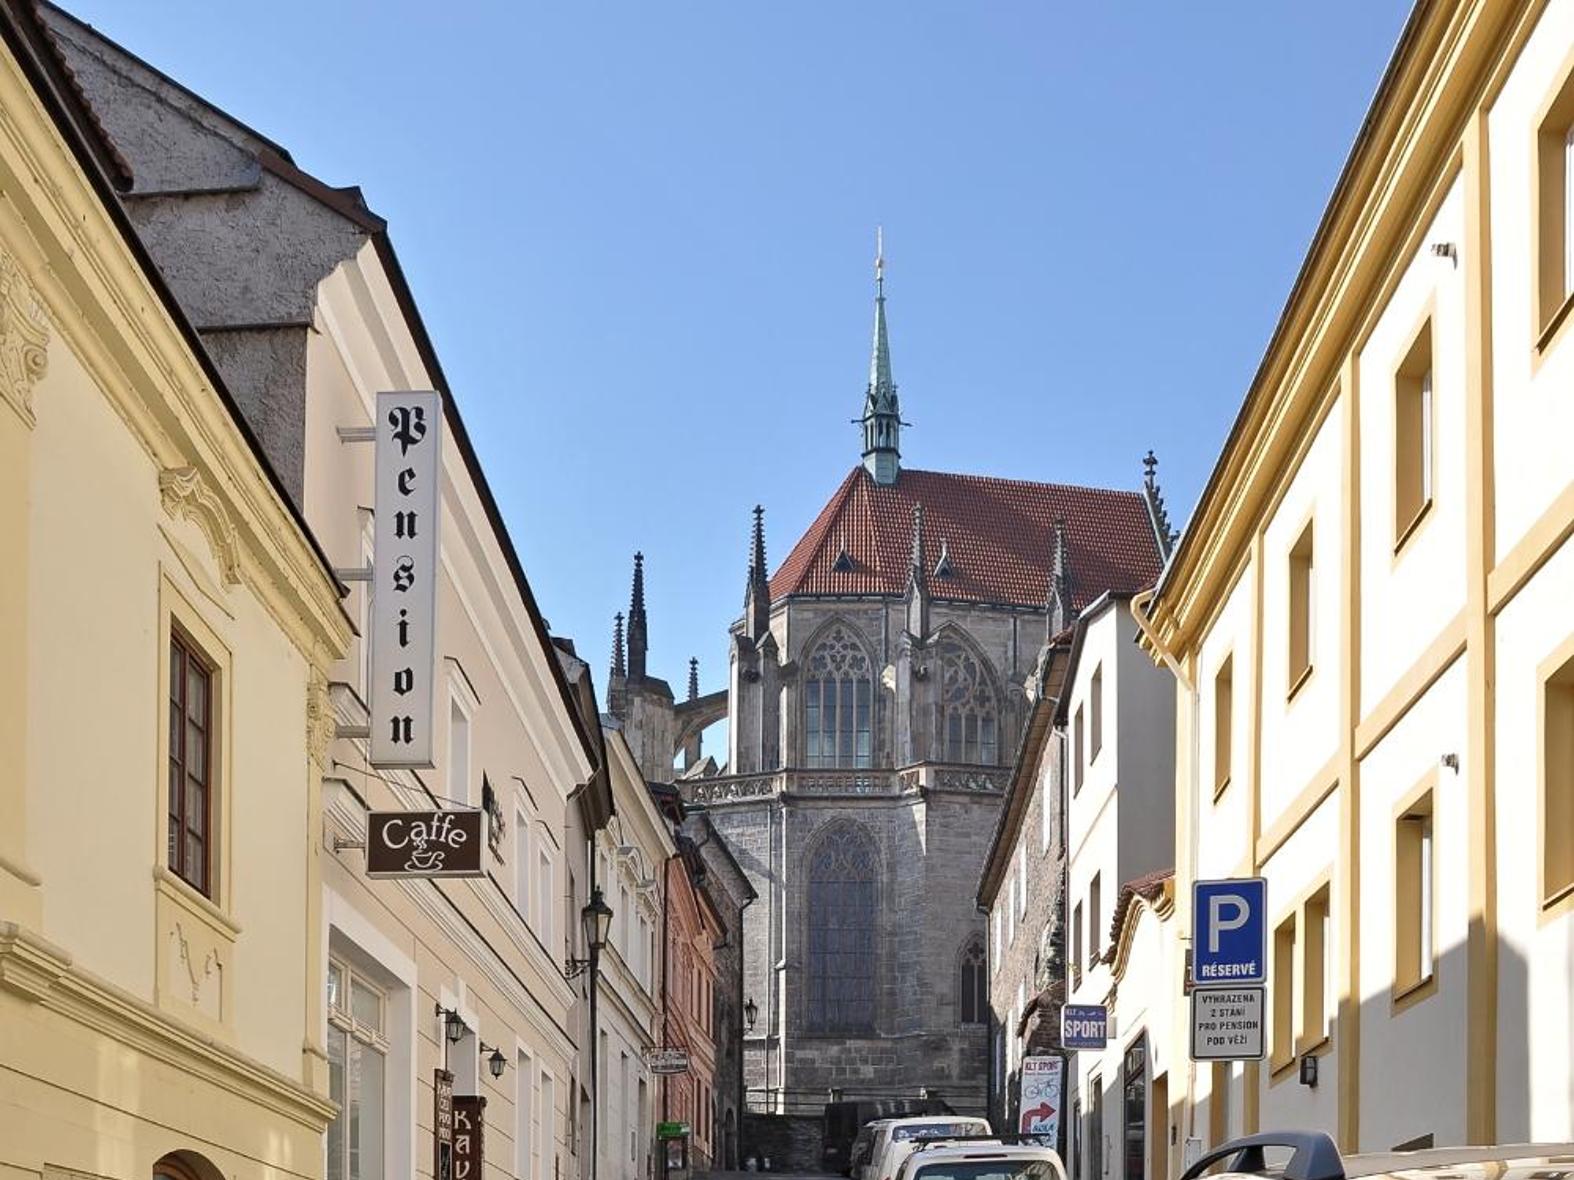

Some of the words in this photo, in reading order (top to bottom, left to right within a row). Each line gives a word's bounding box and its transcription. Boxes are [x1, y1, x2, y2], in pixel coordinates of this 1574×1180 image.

[387, 405, 428, 745] Pension
[381, 811, 467, 849] Caffe
[1208, 894, 1251, 954] P
[1202, 959, 1256, 977] RÉSERVÉ
[1201, 994, 1255, 1004] VYHRAZENA
[1065, 1020, 1106, 1038] SPORT
[1198, 1022, 1217, 1031] PRO
[1219, 1020, 1259, 1031] PENSION
[1206, 1036, 1226, 1046] POD
